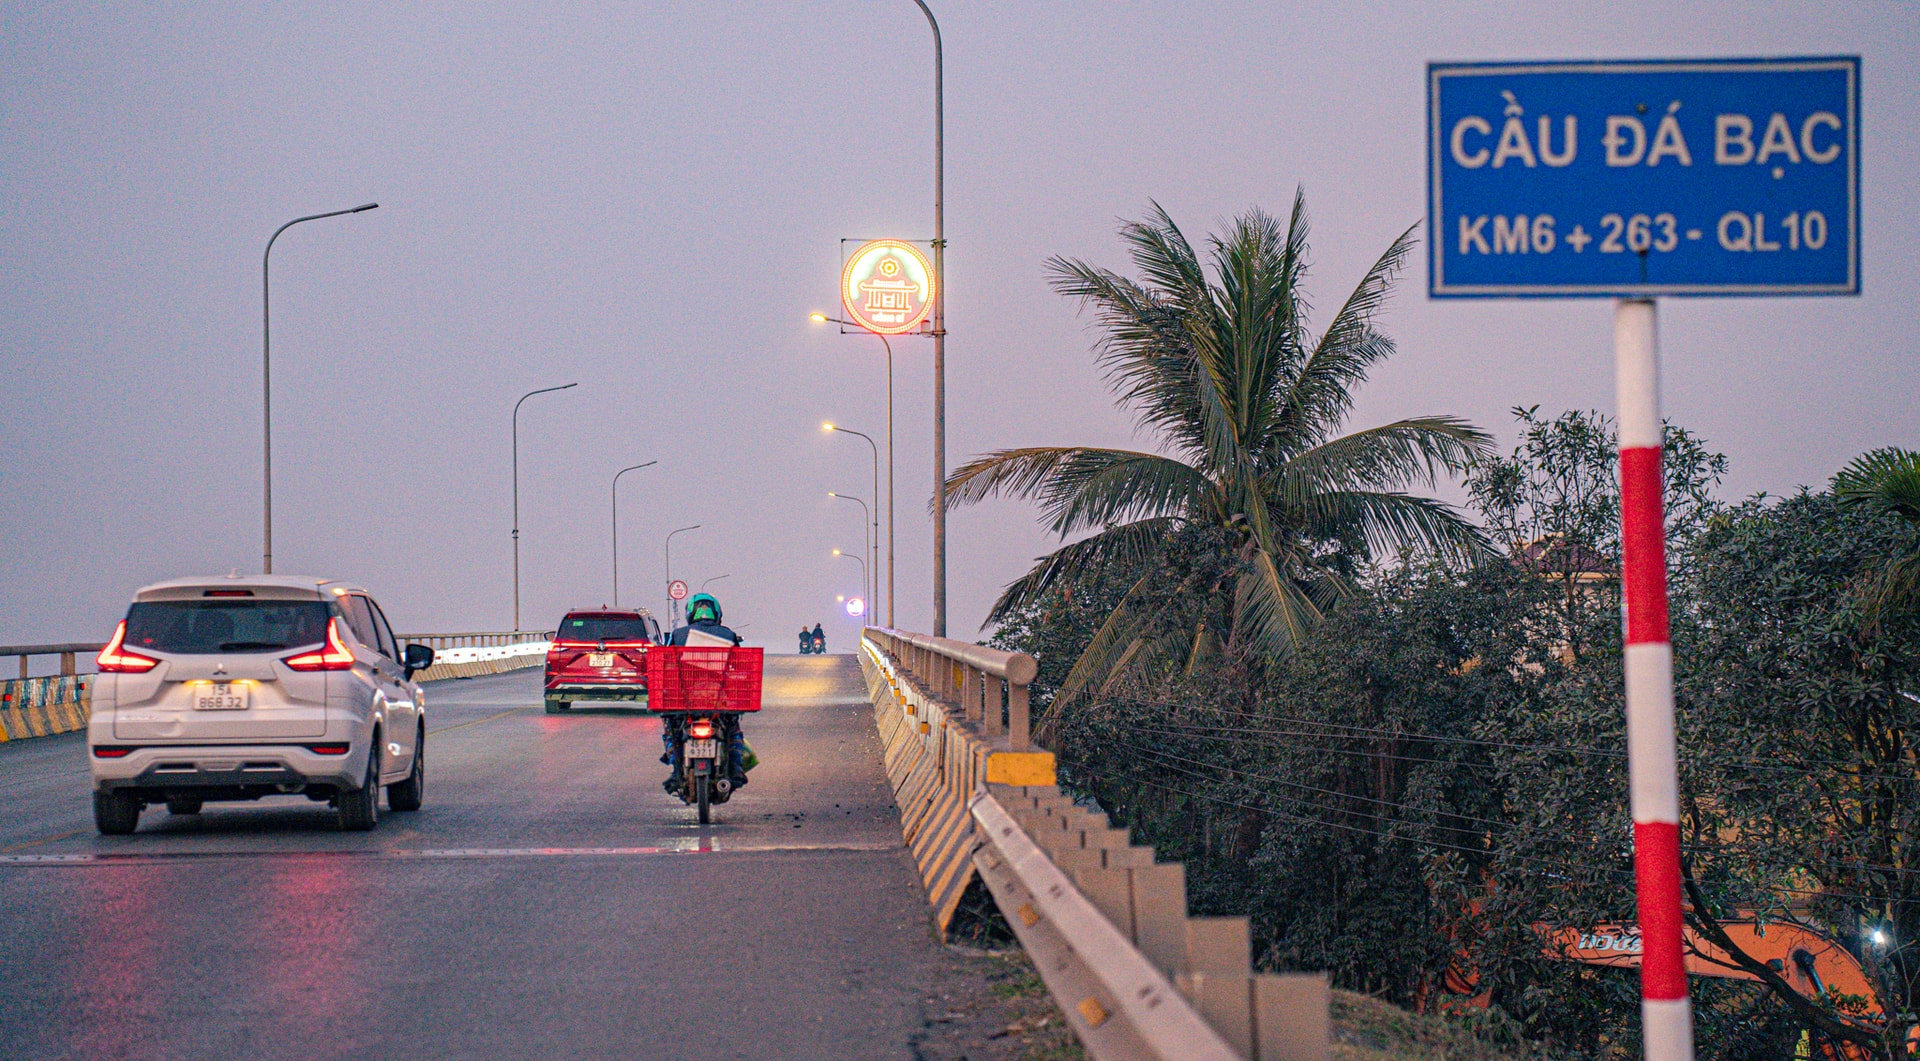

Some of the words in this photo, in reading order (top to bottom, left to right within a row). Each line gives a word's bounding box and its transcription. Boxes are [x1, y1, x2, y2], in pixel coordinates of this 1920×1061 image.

[1450, 90, 1578, 169] CẦU
[1601, 100, 1693, 167] ĐÁ
[1714, 110, 1842, 180] BẠC
[1716, 210, 1828, 252] QL10
[212, 683, 232, 696] 15A
